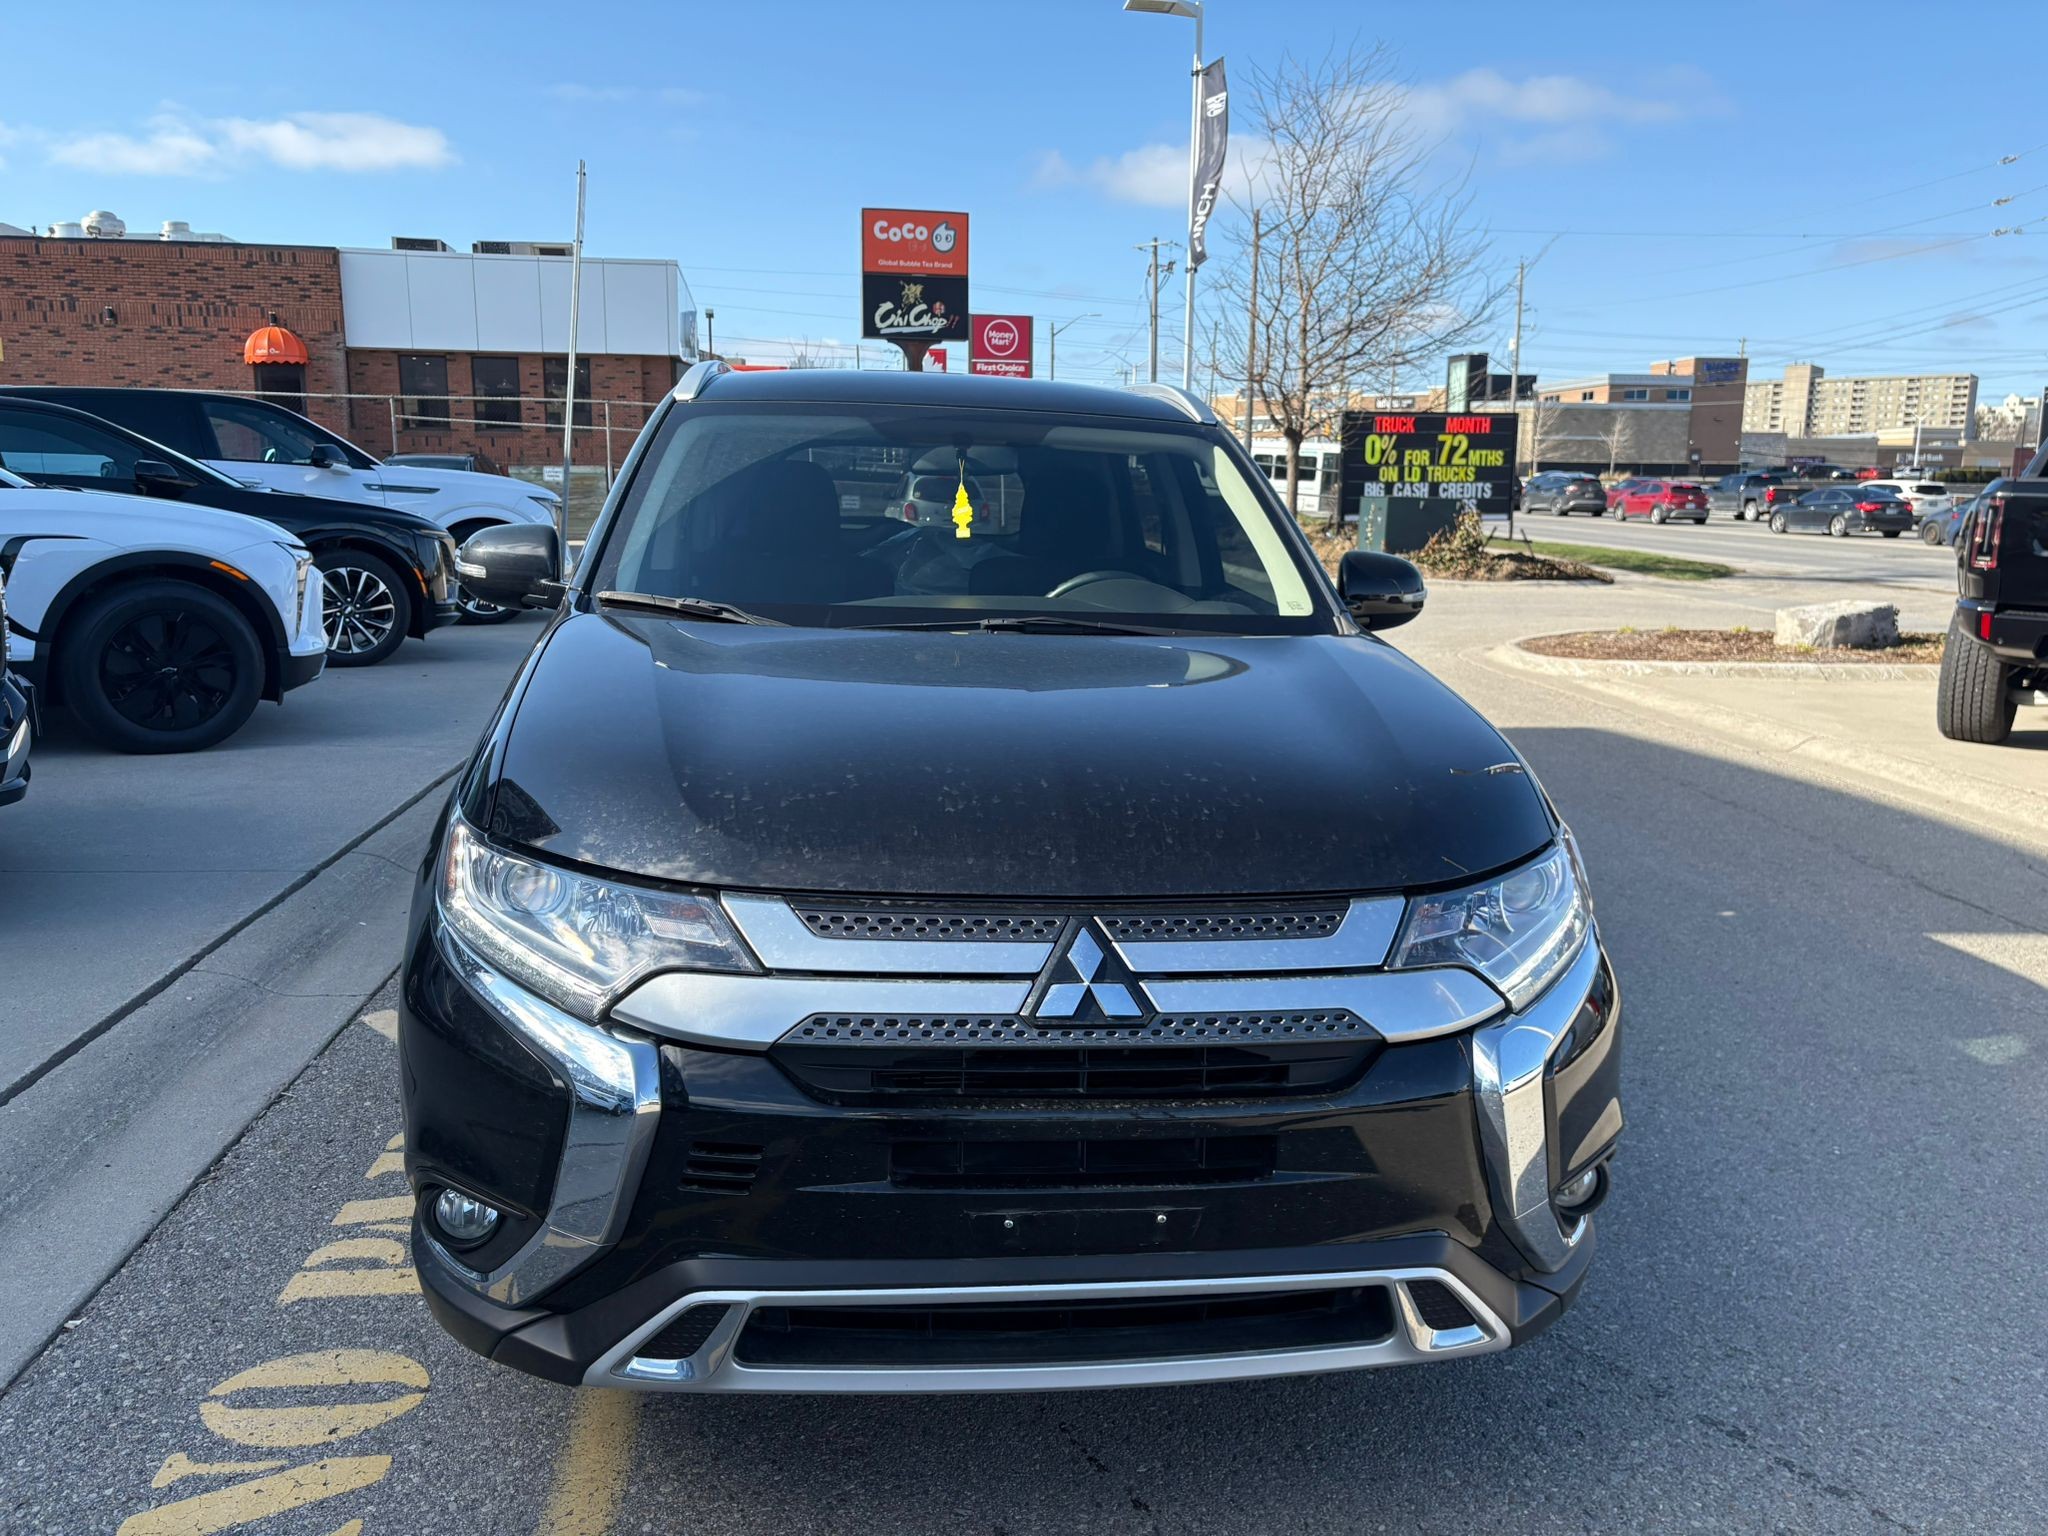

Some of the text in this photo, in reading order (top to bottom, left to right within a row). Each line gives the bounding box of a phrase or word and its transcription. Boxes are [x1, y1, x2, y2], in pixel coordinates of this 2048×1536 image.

[873, 220, 928, 242] CoCo
[899, 260, 921, 268] Bubble
[988, 330, 1014, 341] Money
[991, 338, 1011, 346] Mart
[976, 363, 1025, 372] First Choice
[1374, 416, 1492, 433] TRUCK MONTH
[1364, 434, 1504, 466] 0% FOR 72 MTHS
[1379, 466, 1476, 483] ON LD TRUCKS
[1364, 482, 1492, 499] BIG CASH CREDITS
